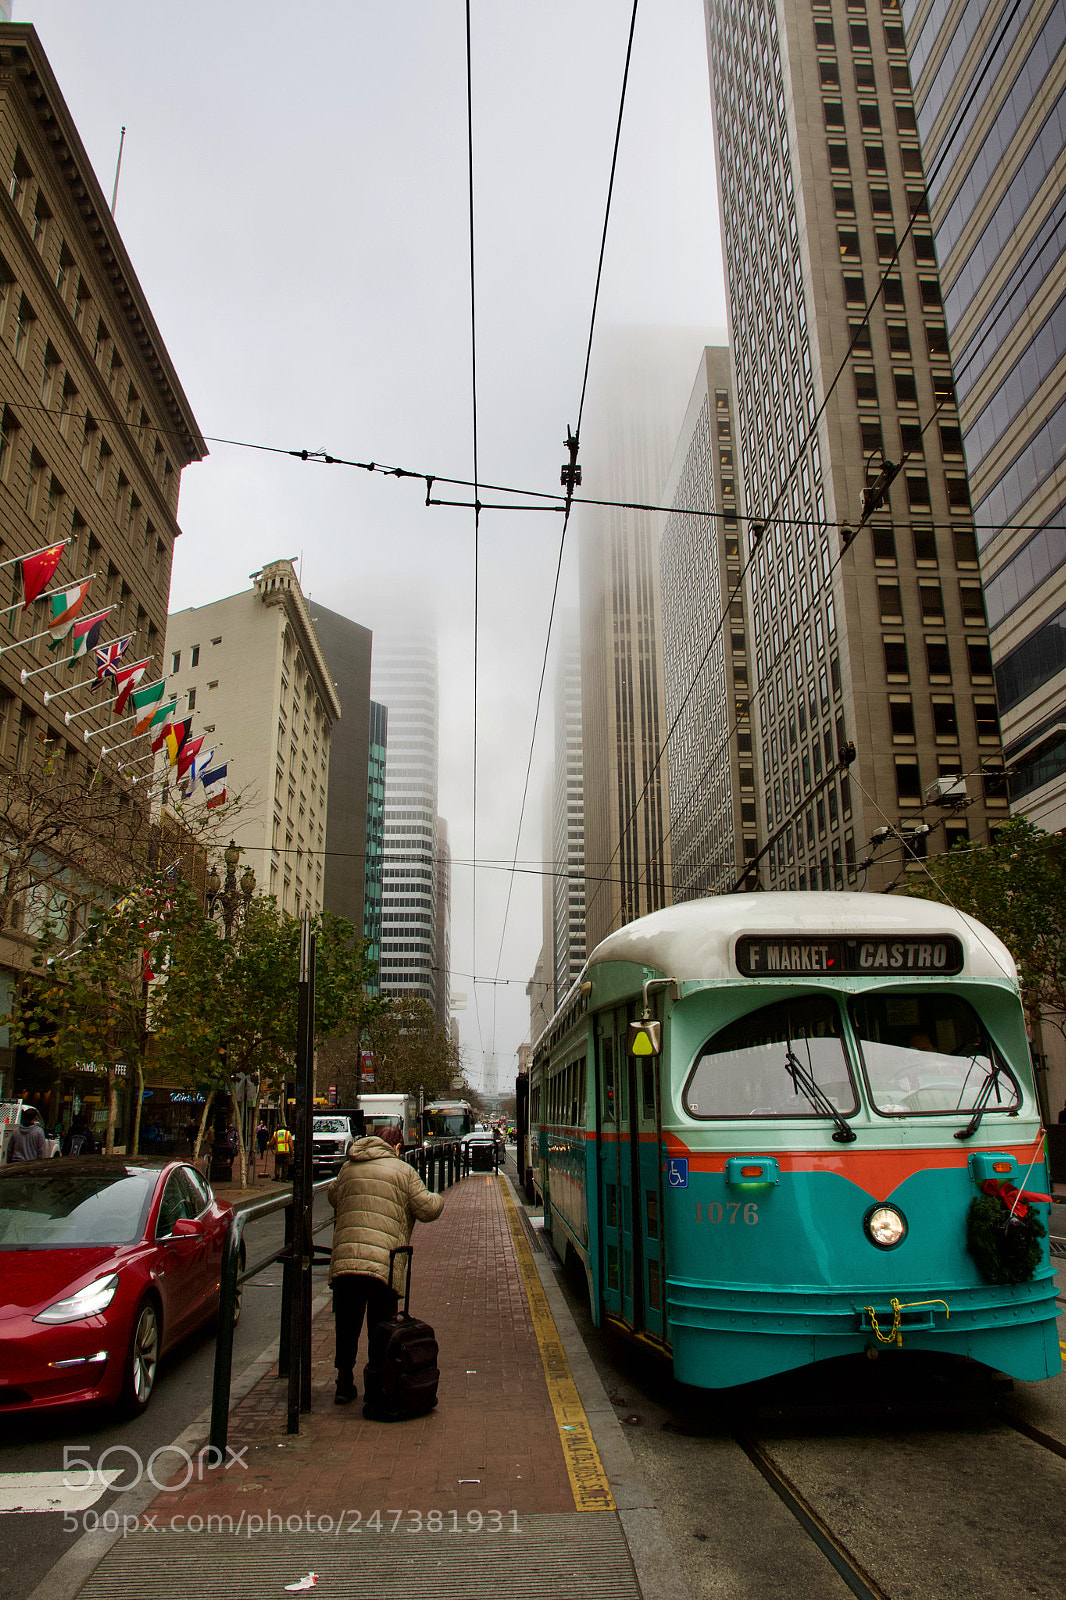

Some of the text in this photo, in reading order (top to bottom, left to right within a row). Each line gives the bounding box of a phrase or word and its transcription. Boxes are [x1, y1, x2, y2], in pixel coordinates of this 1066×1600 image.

[750, 943, 947, 970] F MARKET CASTRO
[694, 1201, 758, 1225] 1076
